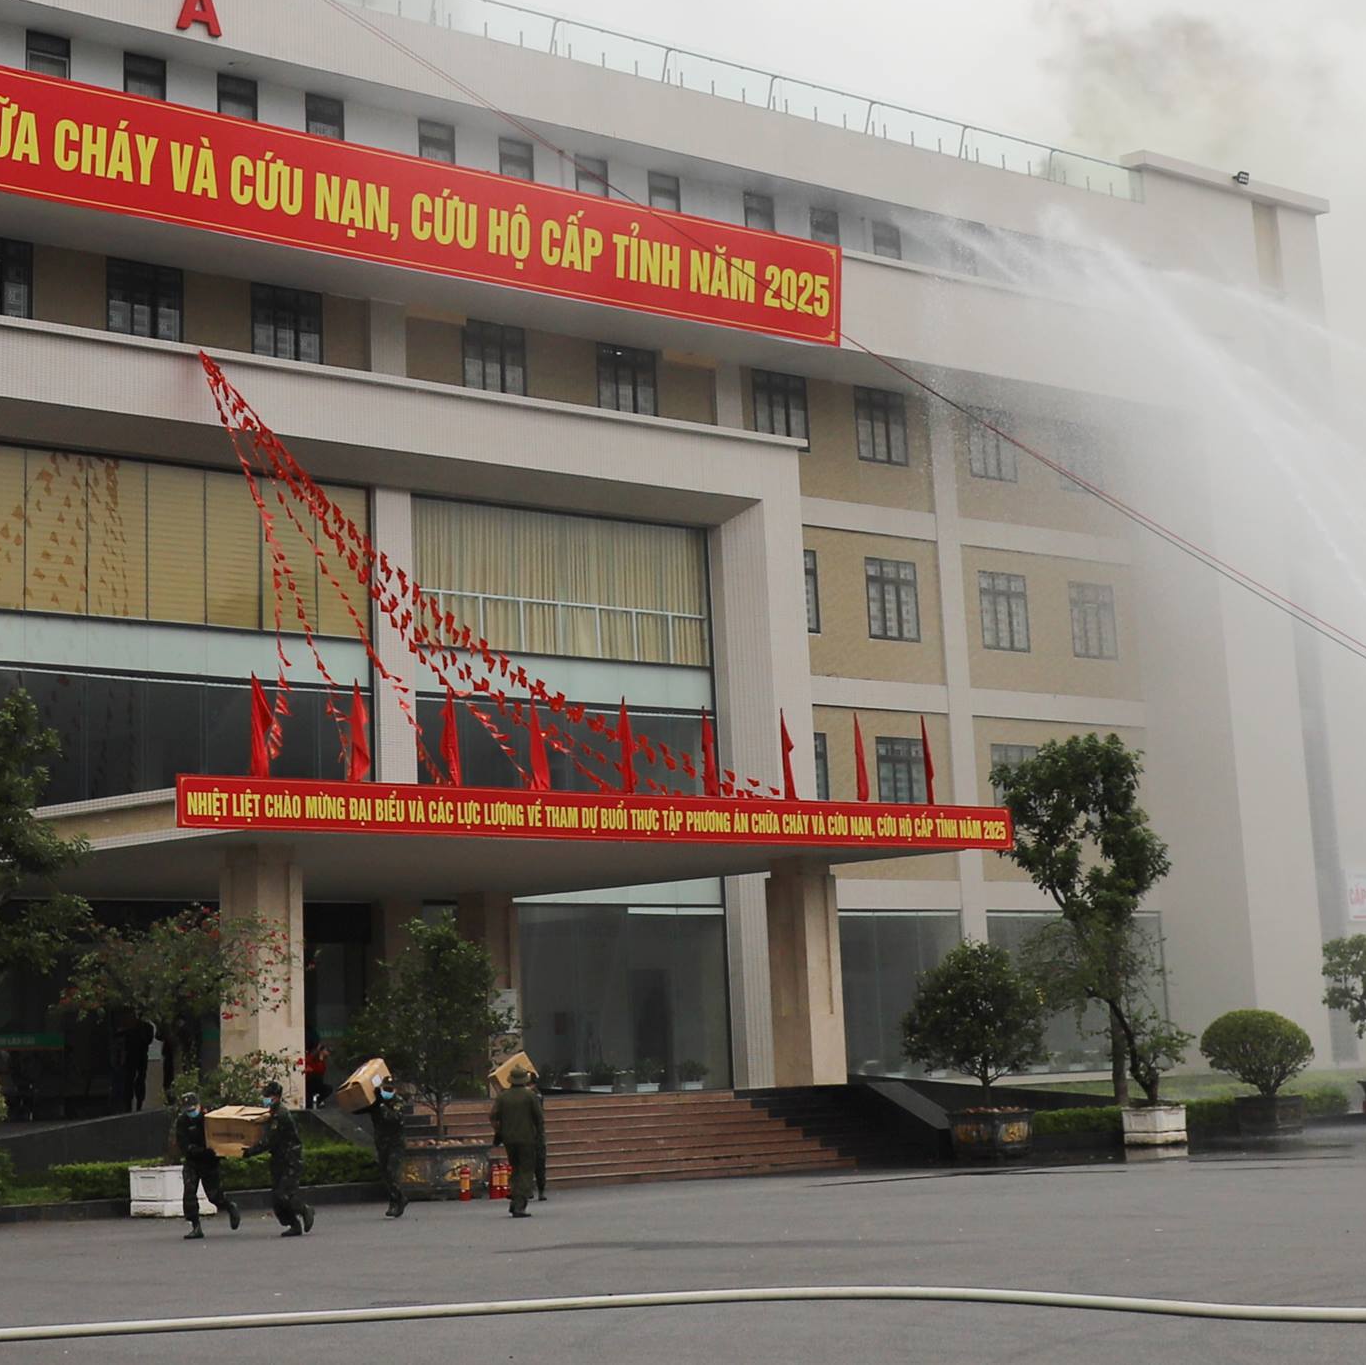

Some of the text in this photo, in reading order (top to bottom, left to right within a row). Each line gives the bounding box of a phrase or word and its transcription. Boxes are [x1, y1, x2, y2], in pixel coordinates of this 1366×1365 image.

[54, 120, 158, 184] CHÁY
[171, 138, 217, 198] VÀ
[231, 152, 303, 215] CỨU
[315, 174, 399, 240] NẠN,
[411, 189, 477, 249] CỨU
[488, 204, 530, 269] HỘ
[541, 211, 603, 272] CẤP
[613, 222, 680, 289] TỈNH
[690, 247, 755, 303] NĂM
[764, 266, 829, 316] 2025
[187, 787, 229, 822] NHIỆT
[232, 788, 261, 822] LIỆT
[264, 790, 302, 818] CHÀO
[305, 791, 346, 819] MỪNG
[349, 797, 372, 826] ĐẠI
[375, 790, 405, 822] BIỂU
[408, 795, 426, 823] VÀ
[428, 796, 454, 823] CÁC
[457, 799, 481, 829] LỰC
[483, 801, 525, 830] LƯỢNG
[545, 806, 579, 828] THAM
[581, 805, 599, 834] DỰ
[600, 800, 628, 830] BUỔI
[631, 807, 660, 835] THỰC
[662, 806, 684, 836] TẬP
[686, 810, 732, 833] PHƯƠNG
[733, 808, 749, 833] ÁN
[751, 809, 781, 834] CHỮA
[782, 810, 810, 834] CHÁY
[811, 811, 826, 835] VÀ
[827, 812, 849, 836] CỨU
[850, 816, 875, 841] NẠN,
[876, 813, 898, 837] CỨU
[898, 814, 913, 841] HỘ
[914, 812, 934, 838] CẤP
[935, 812, 958, 838] TỈNH
[960, 816, 981, 839] NĂM
[983, 821, 1006, 840] 2025
